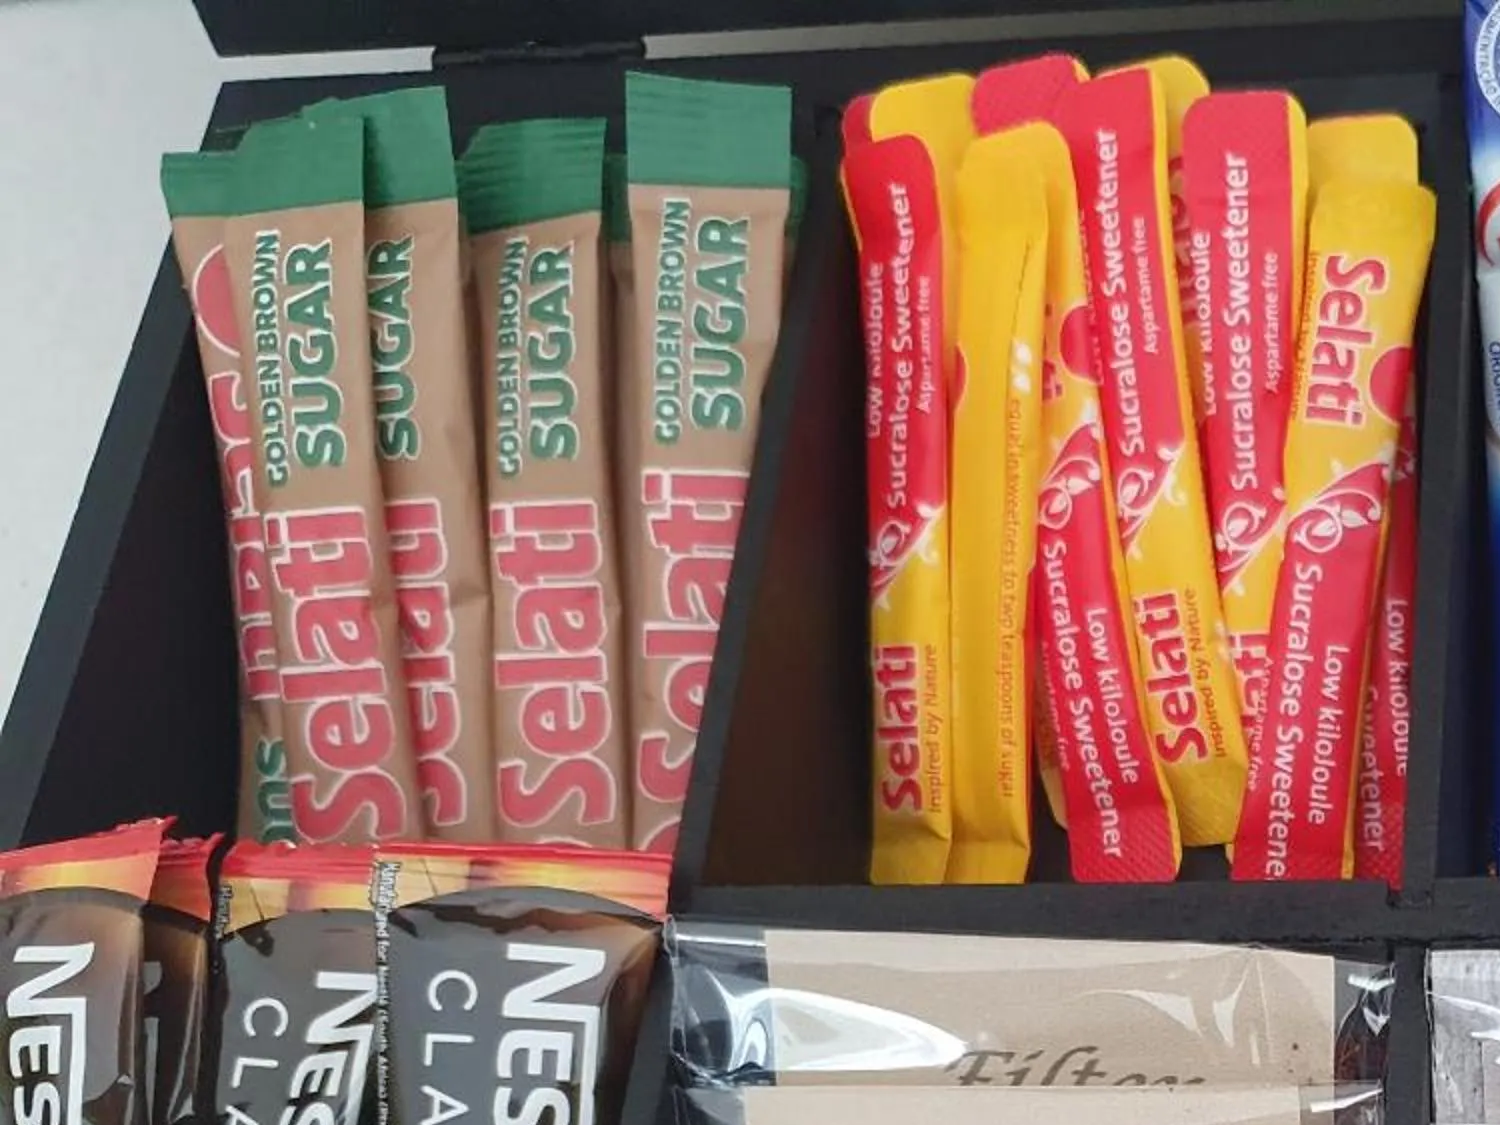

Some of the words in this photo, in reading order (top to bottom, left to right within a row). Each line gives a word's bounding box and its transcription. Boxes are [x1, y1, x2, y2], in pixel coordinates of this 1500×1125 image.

[658, 198, 692, 314] BROWN
[889, 181, 915, 355] Sweetener
[1095, 128, 1128, 301] Sweetener
[1131, 216, 1147, 256] free
[1221, 150, 1252, 330] Sweetener
[1261, 251, 1279, 291] free
[252, 230, 280, 353] BROWN
[284, 239, 346, 468] SUGAR
[367, 234, 420, 460] SUGAR
[499, 237, 529, 348] BROWN
[527, 240, 579, 460] SUGAR
[689, 216, 749, 431] SUGAR
[1135, 258, 1159, 355] Aspartame
[1262, 294, 1281, 394] Aspartame
[1305, 253, 1389, 427] Selati
[257, 356, 289, 488] GOLDEN
[497, 352, 522, 477] GOLDEN
[654, 316, 684, 444] GOLDEN
[887, 360, 914, 508] Sucralose
[1110, 301, 1146, 458] Sucralose
[1227, 337, 1258, 492] Sucralose
[264, 504, 406, 841] Selati
[489, 499, 616, 828] Selati
[924, 643, 940, 707] Nature
[1086, 606, 1111, 664] Low
[1132, 591, 1208, 765] Selati
[1184, 584, 1206, 652] Nature
[1195, 661, 1213, 689] by
[1280, 562, 1322, 717] Sucralose
[1321, 642, 1350, 701] Low
[1386, 598, 1409, 655] Low
[875, 642, 925, 814] Selati
[928, 711, 945, 738] by
[1043, 539, 1084, 691] Sucralose
[1068, 695, 1122, 859] Sweetener
[1096, 667, 1140, 785] kiloJoule
[1199, 692, 1227, 759] Inspired
[921, 738, 944, 814] Inspired
[1264, 725, 1304, 882] Sweetene
[1308, 707, 1345, 826] kiloJoule
